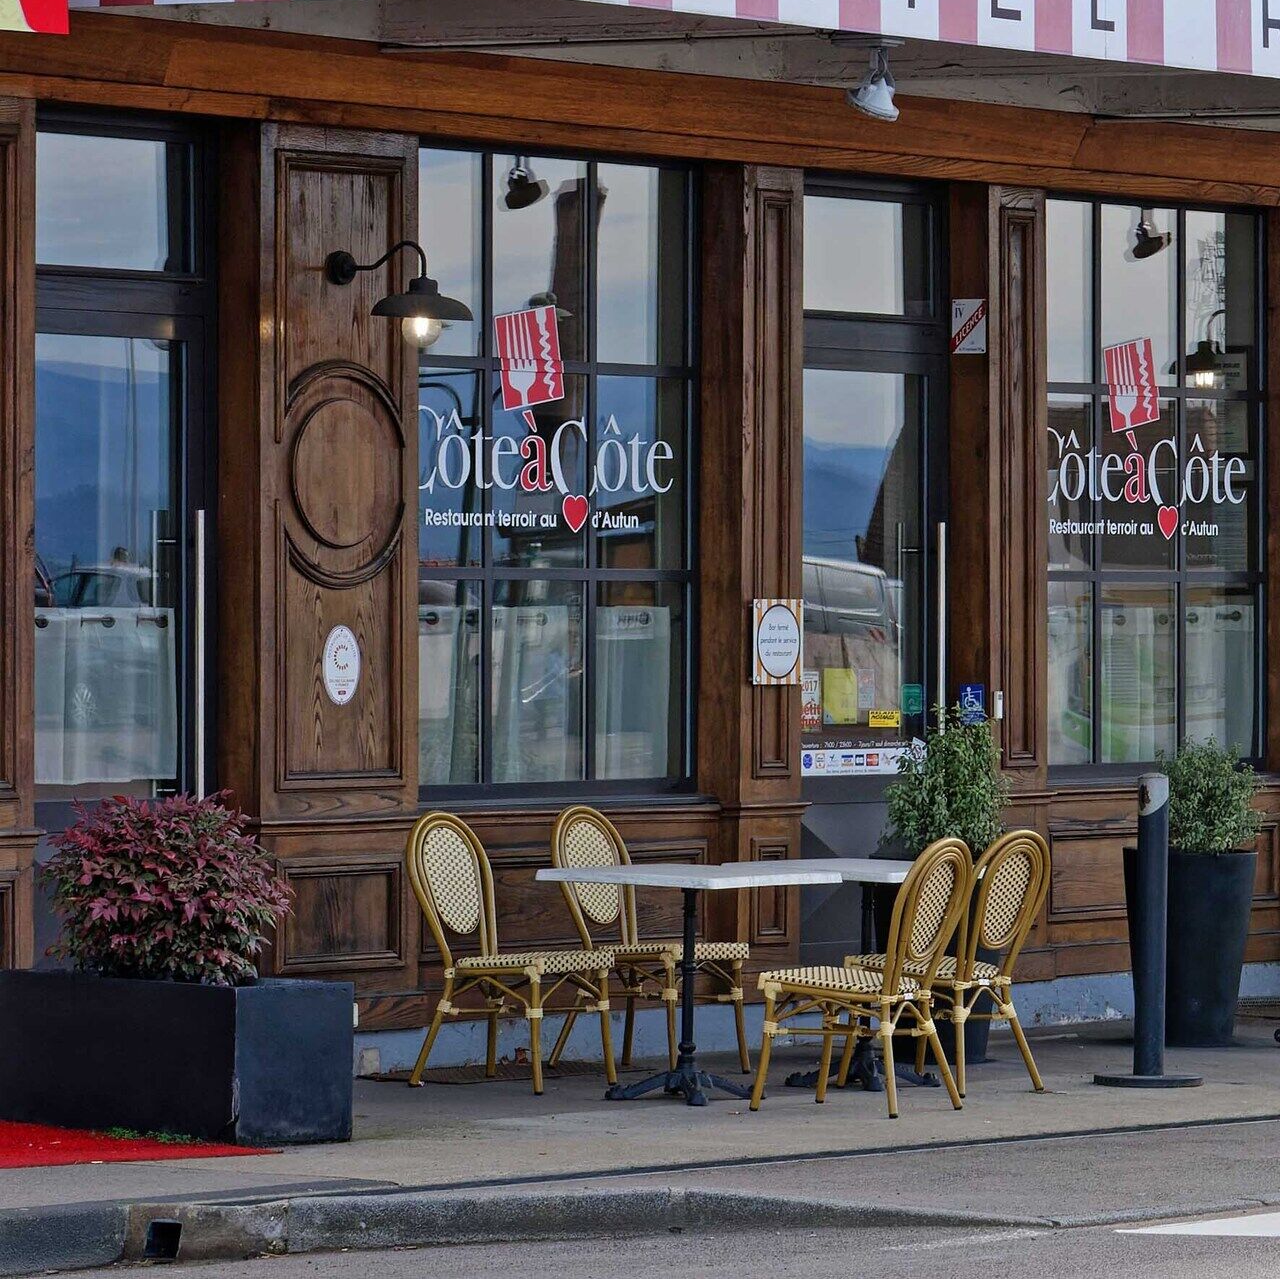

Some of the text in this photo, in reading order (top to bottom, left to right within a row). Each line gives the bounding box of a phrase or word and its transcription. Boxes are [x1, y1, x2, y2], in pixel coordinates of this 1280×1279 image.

[955, 305, 984, 346] LICENCE
[425, 507, 639, 529] Restaurant terroir au d'Autun
[1107, 519, 1138, 535] terroir
[1140, 523, 1154, 535] au
[802, 680, 818, 692] 2017
